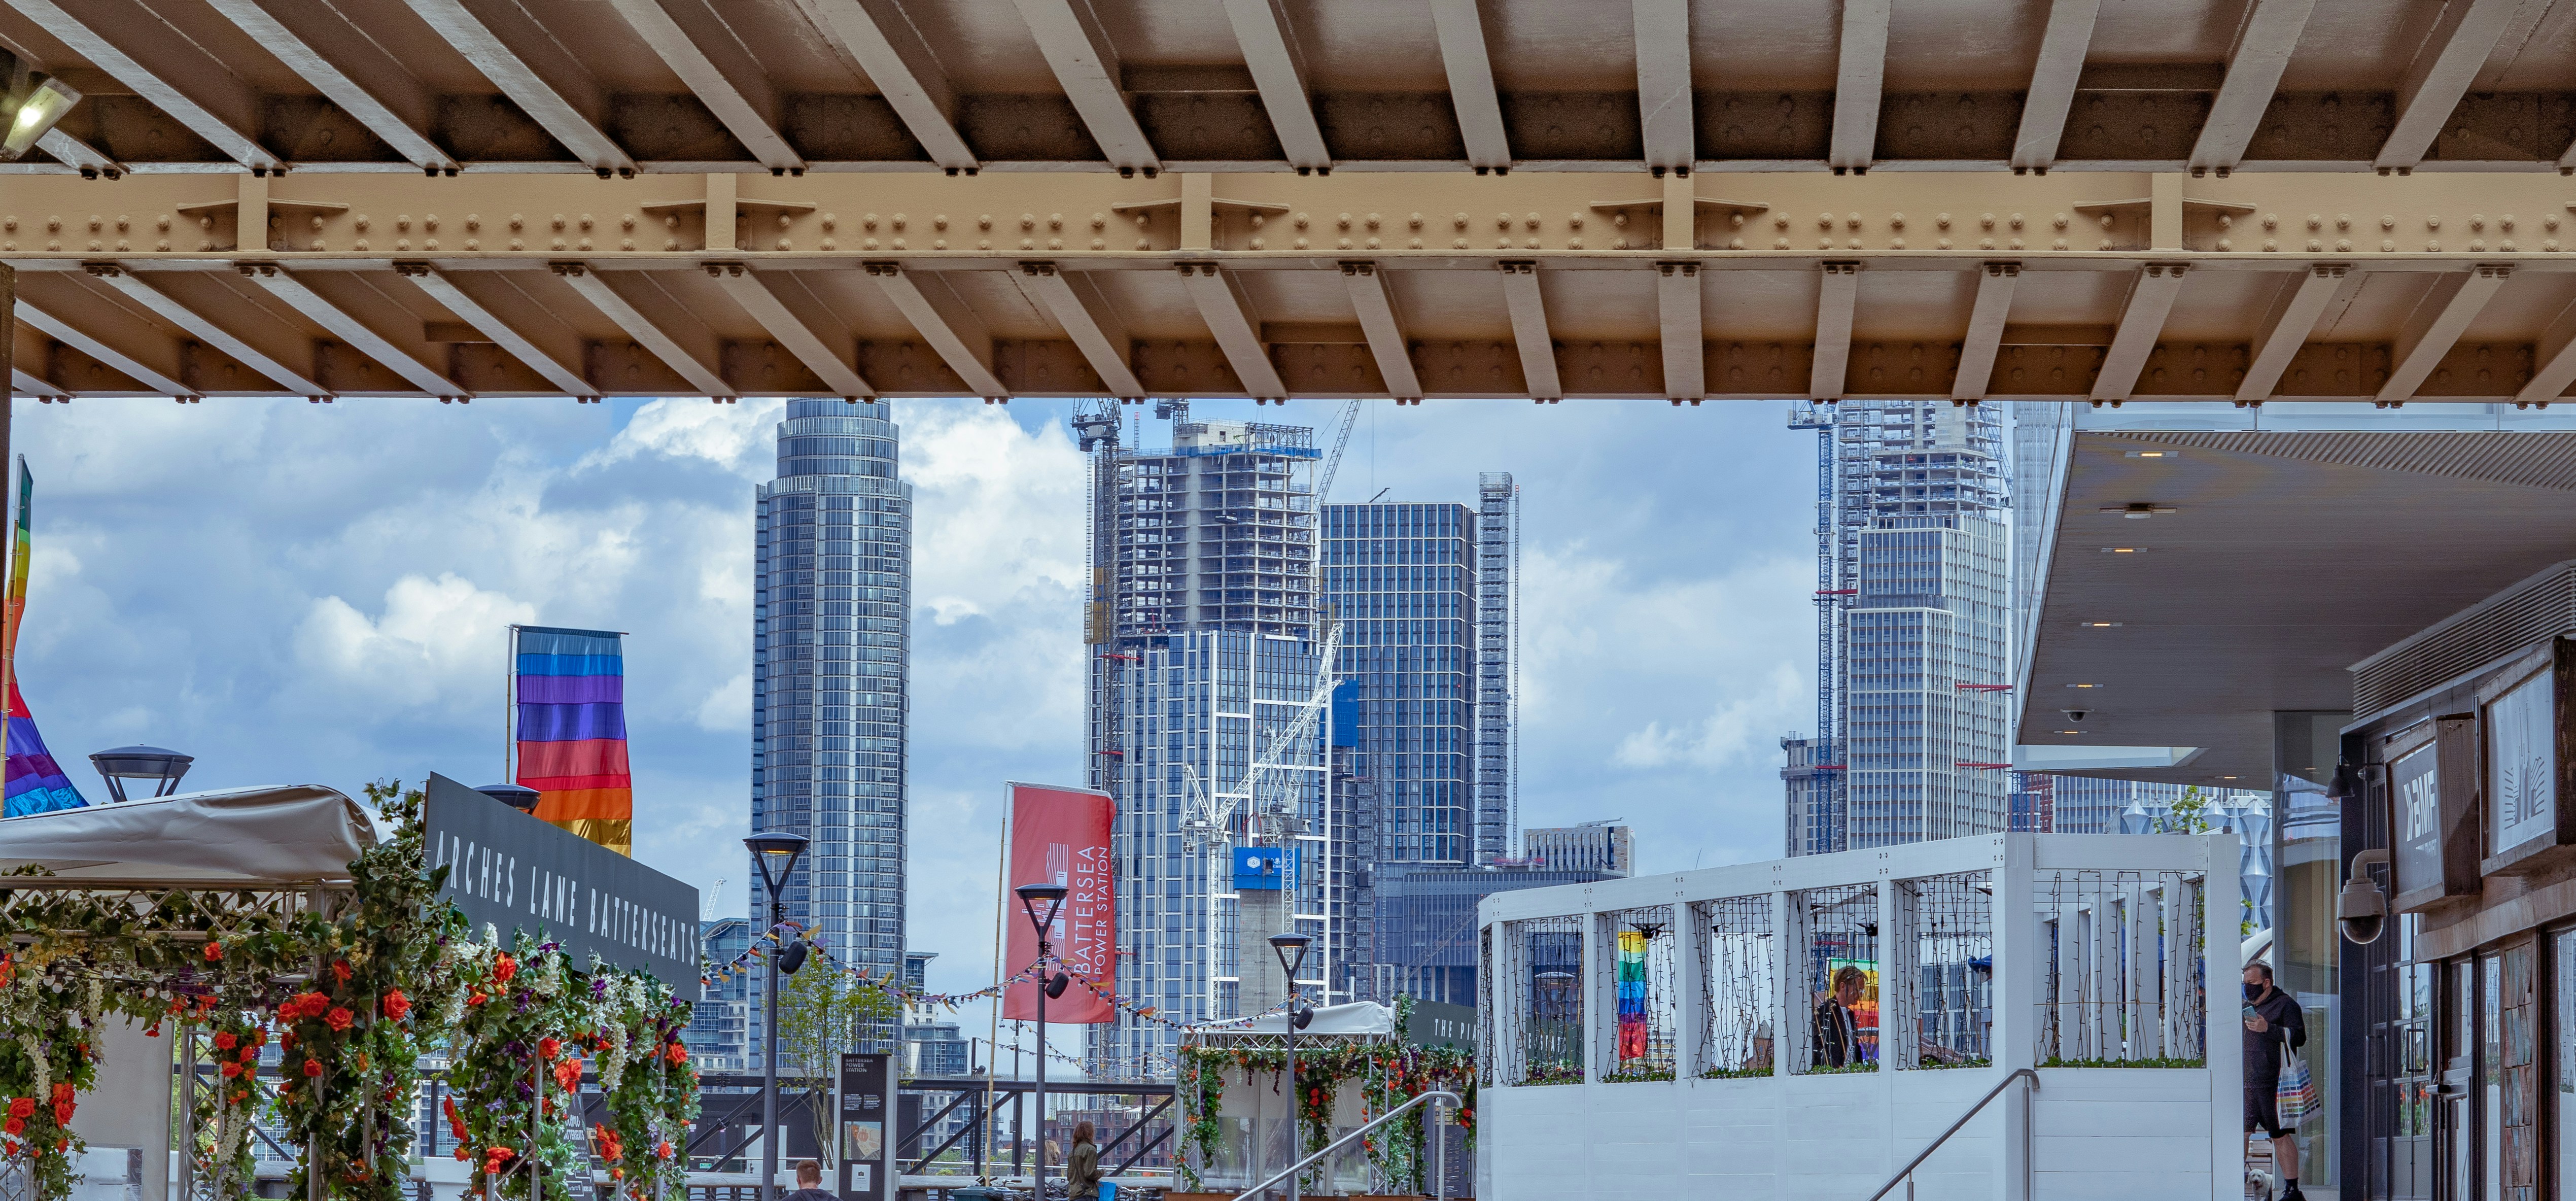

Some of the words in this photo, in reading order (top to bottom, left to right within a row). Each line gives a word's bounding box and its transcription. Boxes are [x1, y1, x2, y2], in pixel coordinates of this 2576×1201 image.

[2412, 770, 2435, 838] BMF
[436, 831, 515, 908] ARCHES
[531, 866, 576, 927] LANE
[589, 888, 694, 966] BATTERSEATS
[1074, 846, 1095, 974] BATTERSEA
[1097, 847, 1108, 912] STATION
[1094, 920, 1107, 975] POWER
[1435, 1018, 1452, 1038] THE
